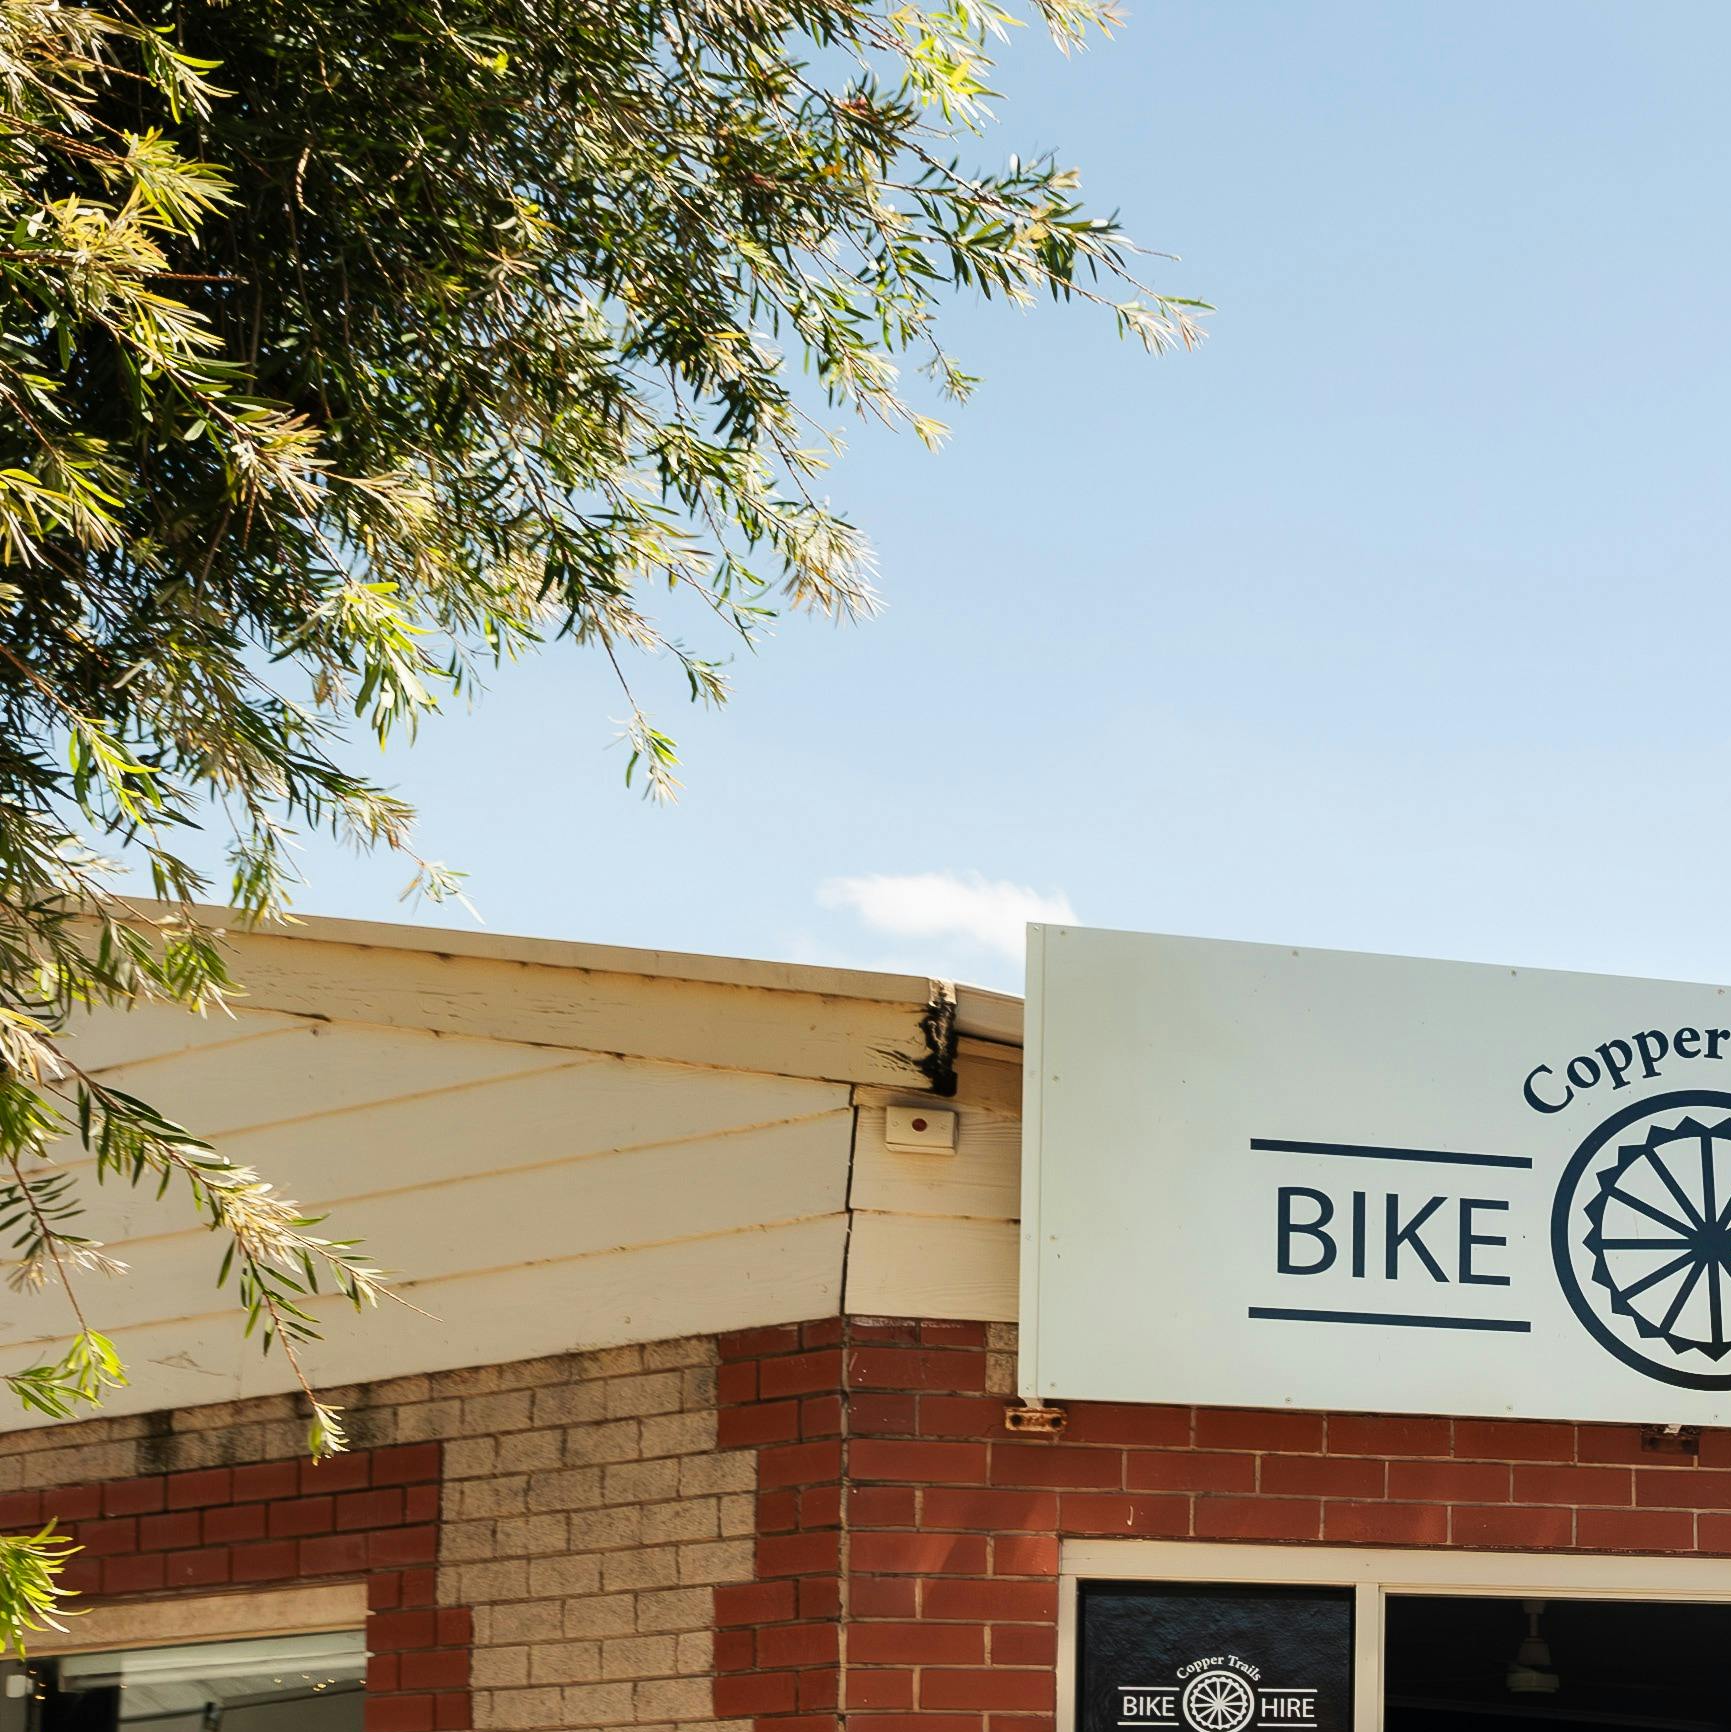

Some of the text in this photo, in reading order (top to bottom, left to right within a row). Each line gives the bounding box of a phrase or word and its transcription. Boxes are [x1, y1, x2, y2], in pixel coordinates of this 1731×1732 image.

[1522, 1026, 1731, 1118] Copper
[1276, 1186, 1511, 1287] BIKE
[1176, 1653, 1262, 1682] Copper Trails
[1123, 1696, 1315, 1718] BIKE HIRE
